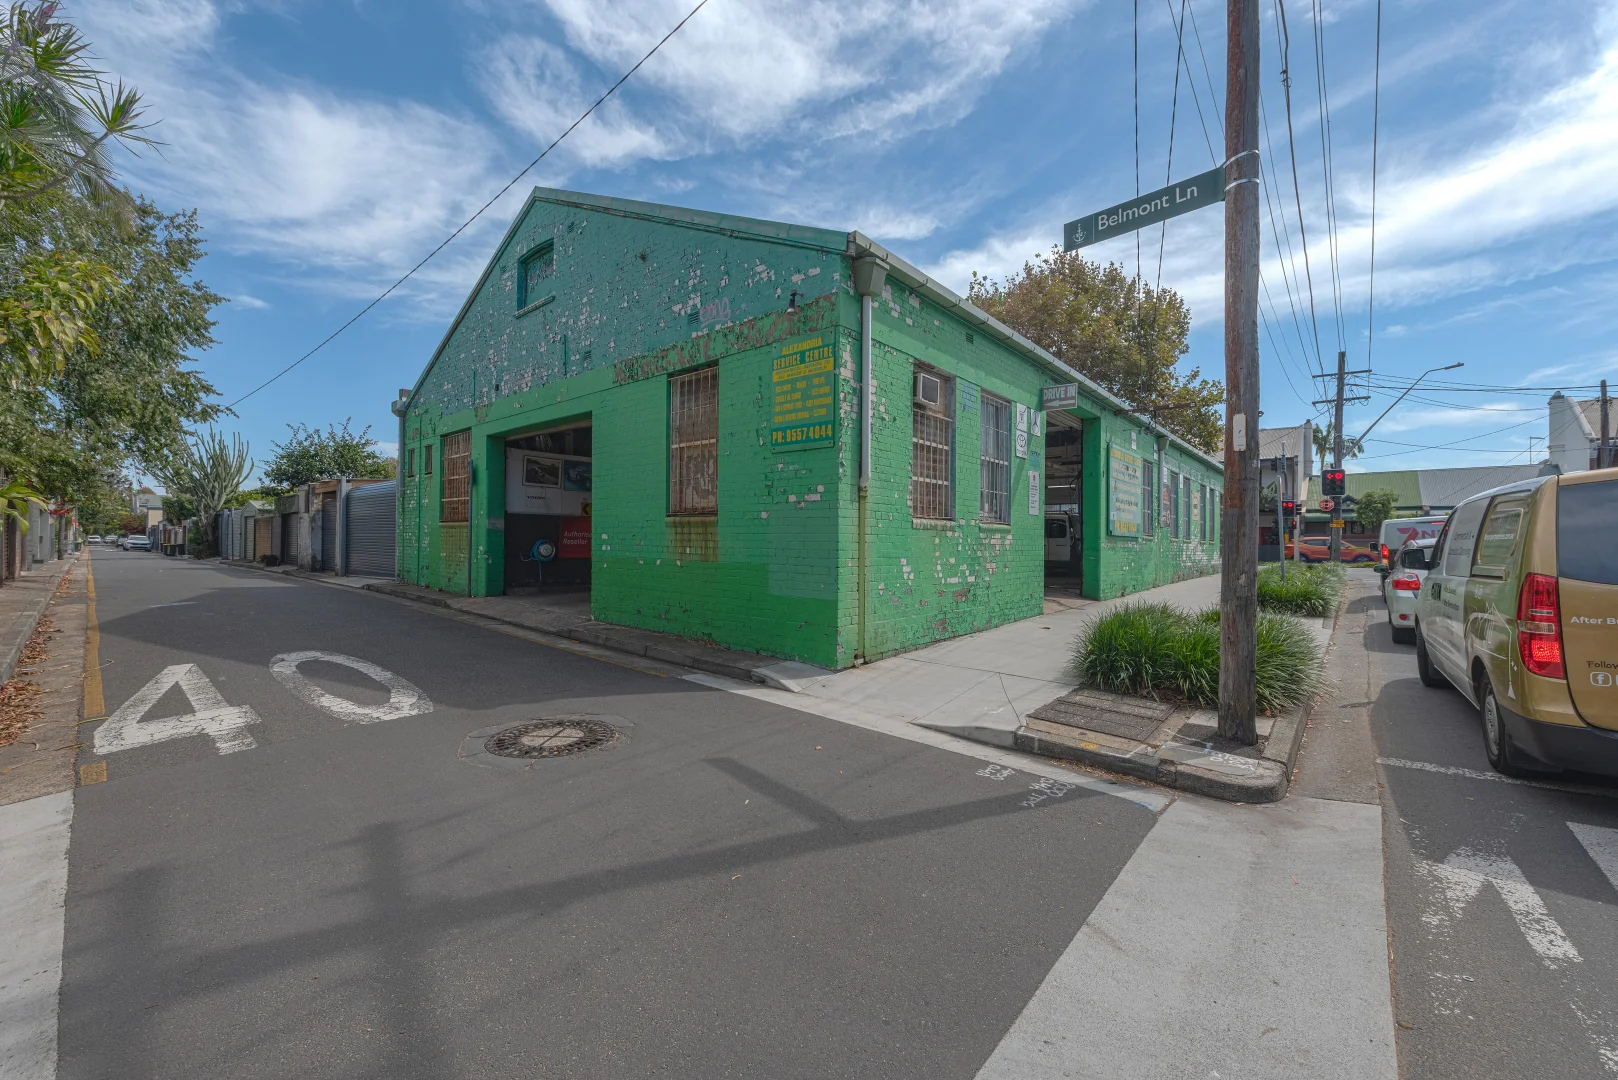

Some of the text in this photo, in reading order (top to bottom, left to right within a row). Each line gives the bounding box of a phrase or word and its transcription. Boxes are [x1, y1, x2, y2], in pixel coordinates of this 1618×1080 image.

[1098, 186, 1198, 231] Belmont Ln
[782, 338, 822, 354] ALEXANDRIA
[773, 346, 833, 370] SERVICE CENTRE
[1043, 385, 1076, 400] DRIVE IN
[773, 424, 833, 443] PH: 9557 4044
[1570, 616, 1603, 625] After
[93, 650, 434, 756] 40
